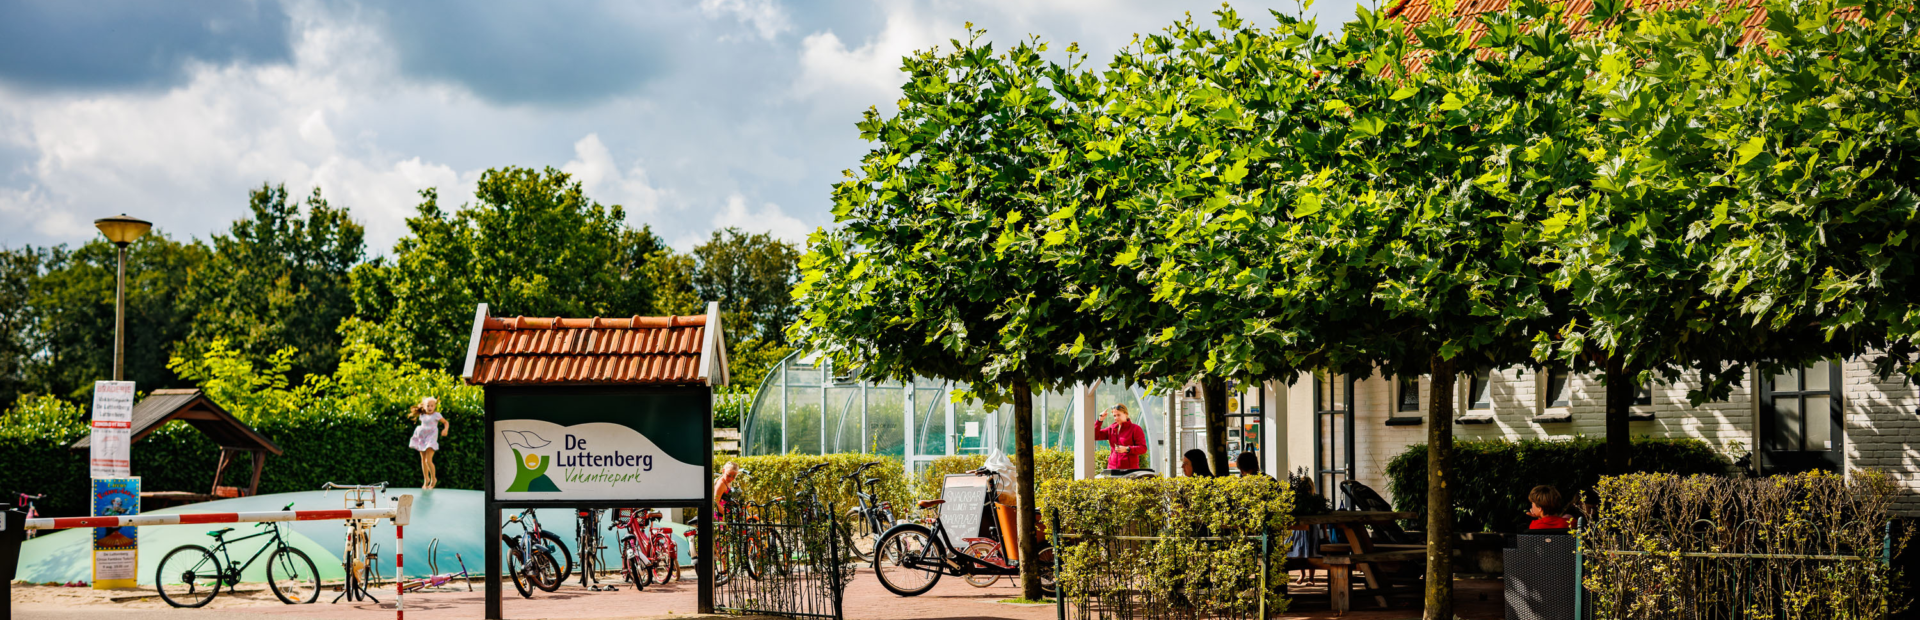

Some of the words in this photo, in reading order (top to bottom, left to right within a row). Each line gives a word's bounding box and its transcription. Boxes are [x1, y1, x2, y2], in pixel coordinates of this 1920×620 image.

[97, 385, 132, 394] BRADERIE
[565, 434, 587, 450] De
[556, 450, 653, 471] Luttenberg
[564, 467, 642, 487] Vakantiepark
[946, 490, 982, 503] SNACKBAR
